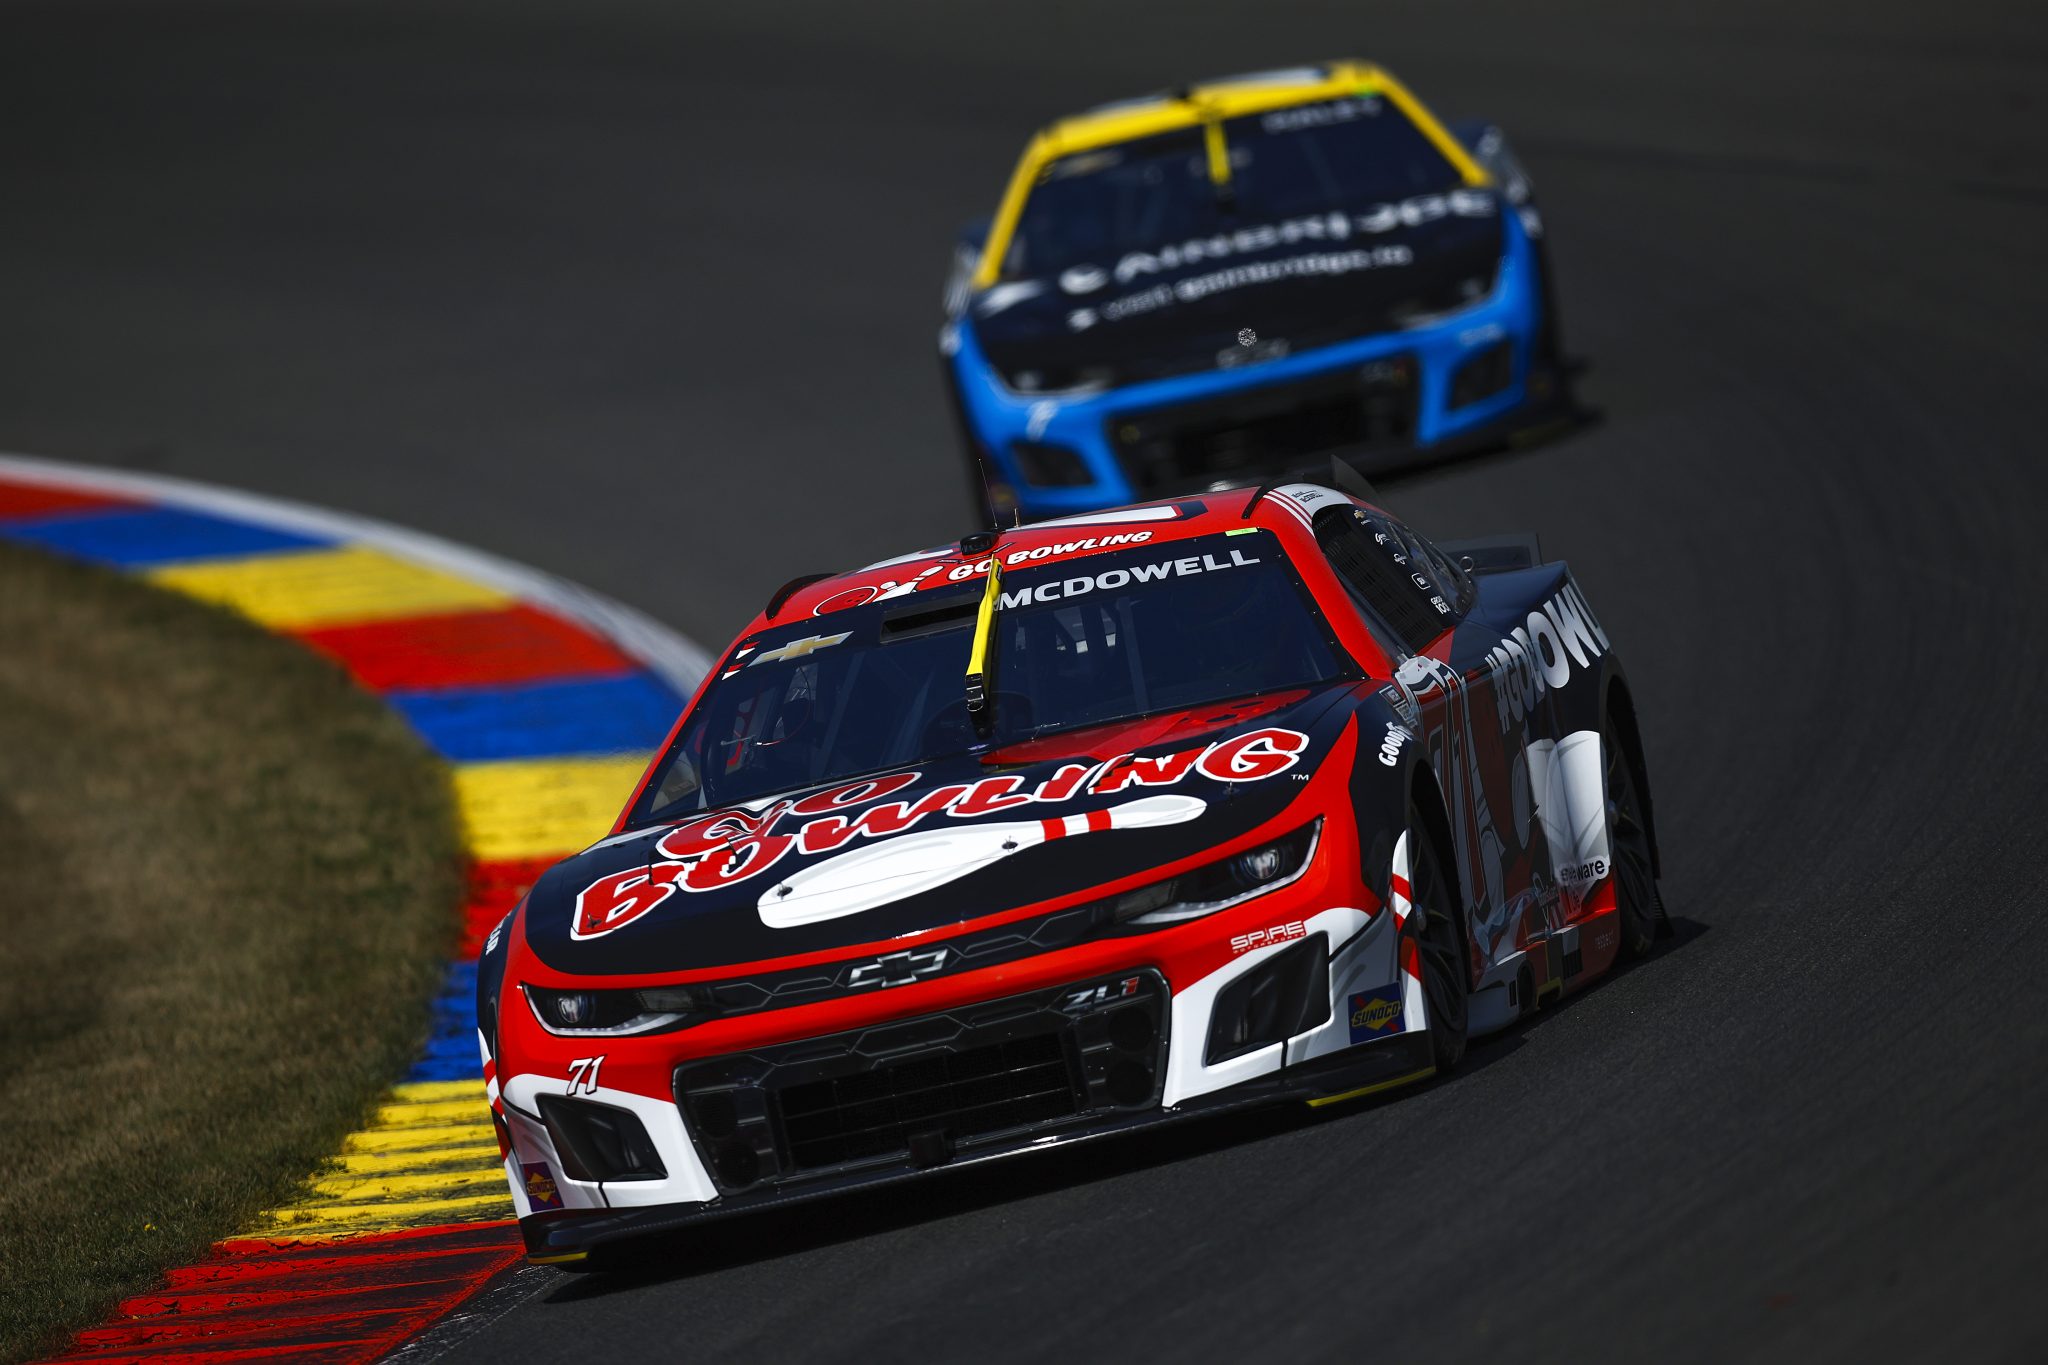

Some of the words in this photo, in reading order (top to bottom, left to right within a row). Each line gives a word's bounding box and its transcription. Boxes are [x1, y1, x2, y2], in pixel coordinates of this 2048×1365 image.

[948, 559, 1001, 581] GO
[1006, 530, 1153, 566] BOWLING
[998, 549, 1260, 611] MCDOWELL
[570, 728, 1310, 941] BOWLING
[656, 771, 923, 860] GO
[1230, 920, 1304, 950] SPIRE
[1352, 1001, 1400, 1026] SUNOCO
[566, 1054, 607, 1096] 71
